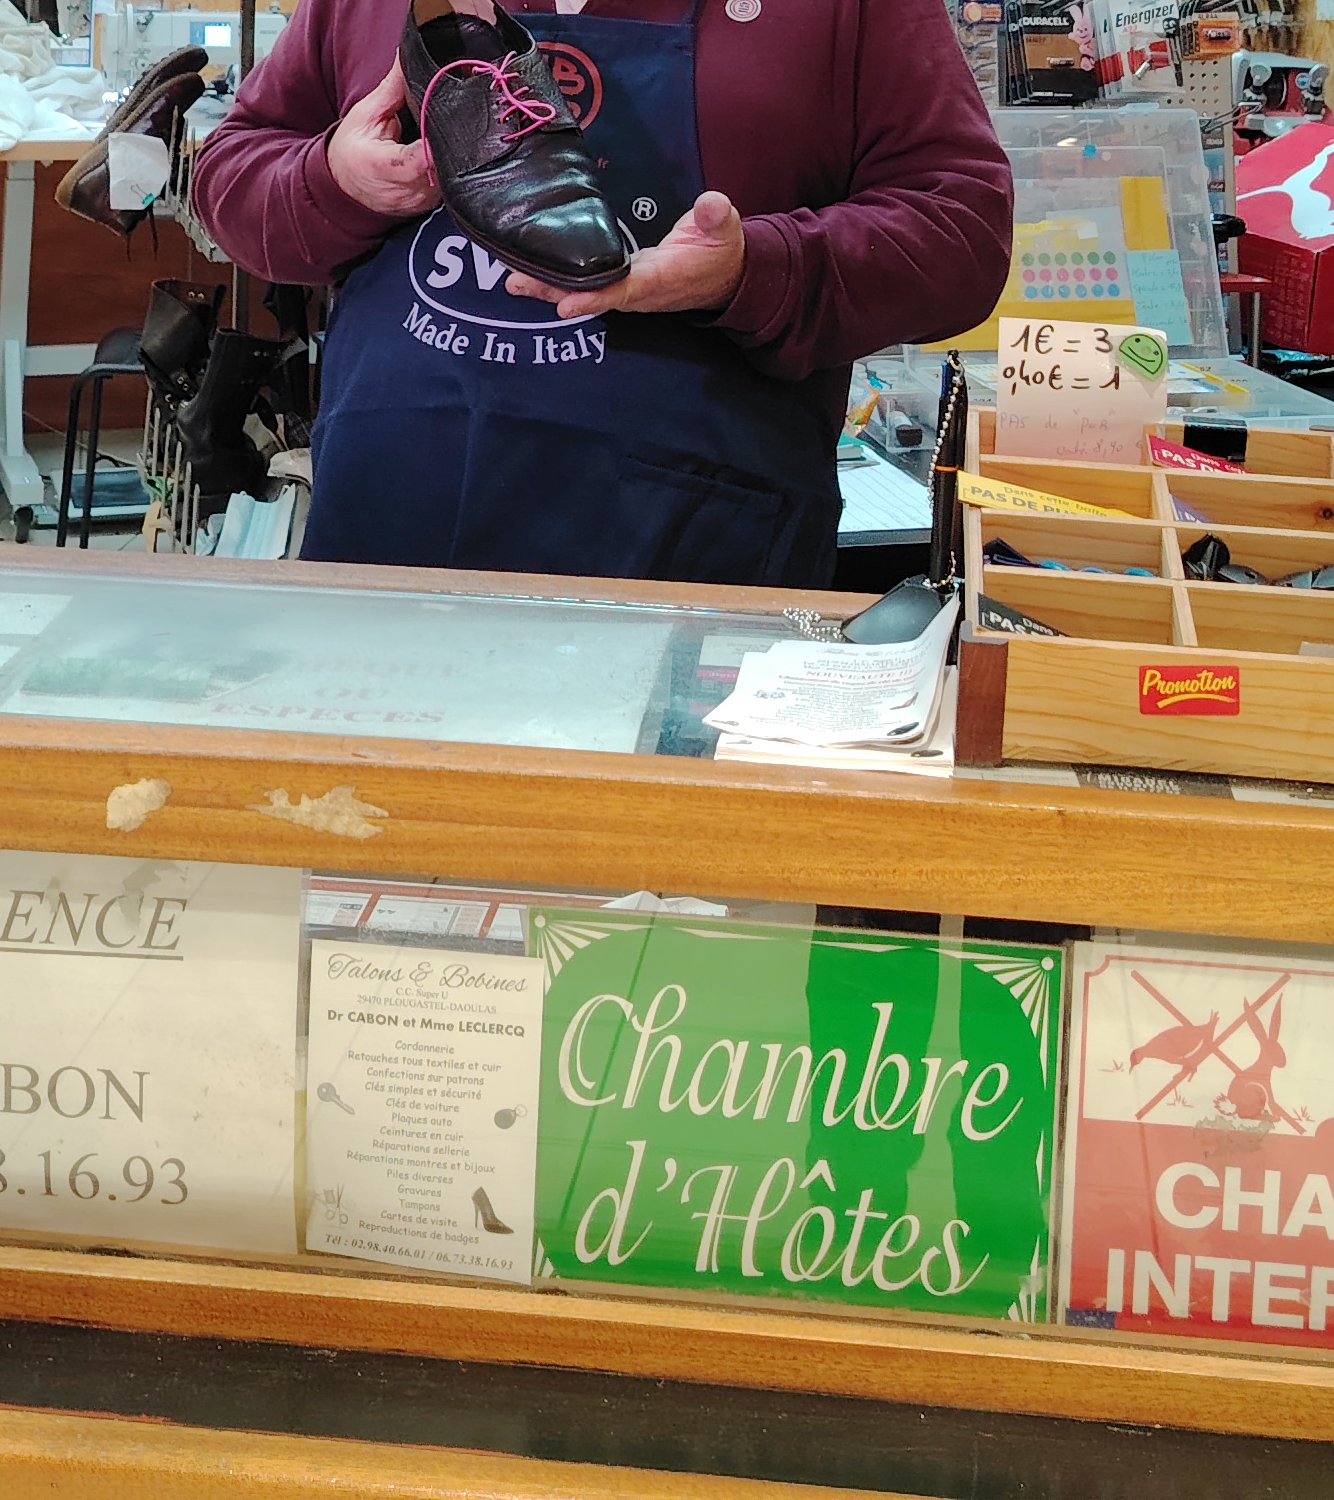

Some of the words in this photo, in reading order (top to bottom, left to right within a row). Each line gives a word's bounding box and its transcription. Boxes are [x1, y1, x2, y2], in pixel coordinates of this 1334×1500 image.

[1022, 16, 1070, 27] DURACELL
[1115, 3, 1175, 28] Energizer
[402, 302, 469, 355] Made
[479, 332, 516, 364] In
[532, 328, 606, 364] Italy
[1093, 328, 1114, 352] 3
[1099, 366, 1120, 391] 1
[1161, 448, 1196, 469] PAS
[970, 485, 1007, 504] PAS
[1012, 497, 1037, 512] DE
[1142, 669, 1237, 697] Promotion
[327, 952, 405, 983] Talons
[408, 961, 433, 988] &
[439, 964, 528, 994] Bobines
[415, 988, 439, 1001] Super
[441, 990, 449, 1000] U
[327, 1009, 344, 1022] Dr
[347, 1012, 399, 1028] CABON
[402, 1017, 416, 1028] et
[420, 1018, 455, 1032] Mme
[458, 1021, 525, 1039] LECLERCQ
[395, 1040, 455, 1056] Cordonnerie
[348, 1051, 399, 1066] Retouches
[401, 1056, 422, 1067] tous
[426, 1058, 466, 1071] textiles
[468, 1060, 479, 1071] et
[481, 1061, 502, 1073] cuir
[557, 983, 1024, 1142] Chambre
[366, 1067, 425, 1082] Confections
[427, 1073, 444, 1084] sur
[446, 1075, 485, 1088] patrons
[364, 1081, 385, 1093] Clés
[387, 1083, 425, 1098] simples
[427, 1086, 438, 1097] et
[440, 1087, 482, 1101] sécurité
[385, 1097, 407, 1110] Clés
[408, 1099, 421, 1111] de
[422, 1101, 460, 1114] voiture
[391, 1112, 429, 1128] Plaques
[431, 1116, 453, 1128] auto
[379, 1125, 427, 1140] Ceintures
[429, 1130, 441, 1141] en
[443, 1131, 464, 1143] cuir
[372, 1138, 430, 1155] Réparations
[432, 1143, 470, 1157] sellerie
[346, 1149, 405, 1166] Réparations
[407, 1157, 447, 1171] montres
[450, 1161, 462, 1171] et
[464, 1161, 496, 1176] bijoux
[386, 1168, 410, 1182] Piles
[412, 1171, 454, 1186] diverses
[397, 1184, 442, 1199] Gravures
[399, 1199, 441, 1214] Tampons
[380, 1209, 413, 1223] Cartes
[416, 1214, 429, 1226] de
[431, 1215, 458, 1228] visite
[574, 1138, 990, 1297] d'Hôtes
[358, 1219, 428, 1241] Reproductions
[430, 1229, 443, 1241] de
[445, 1230, 480, 1246] badges
[325, 1234, 342, 1246] Tél
[351, 1238, 427, 1260] 02.98.40.66.01
[436, 1250, 514, 1272] 06.73.38.16.93
